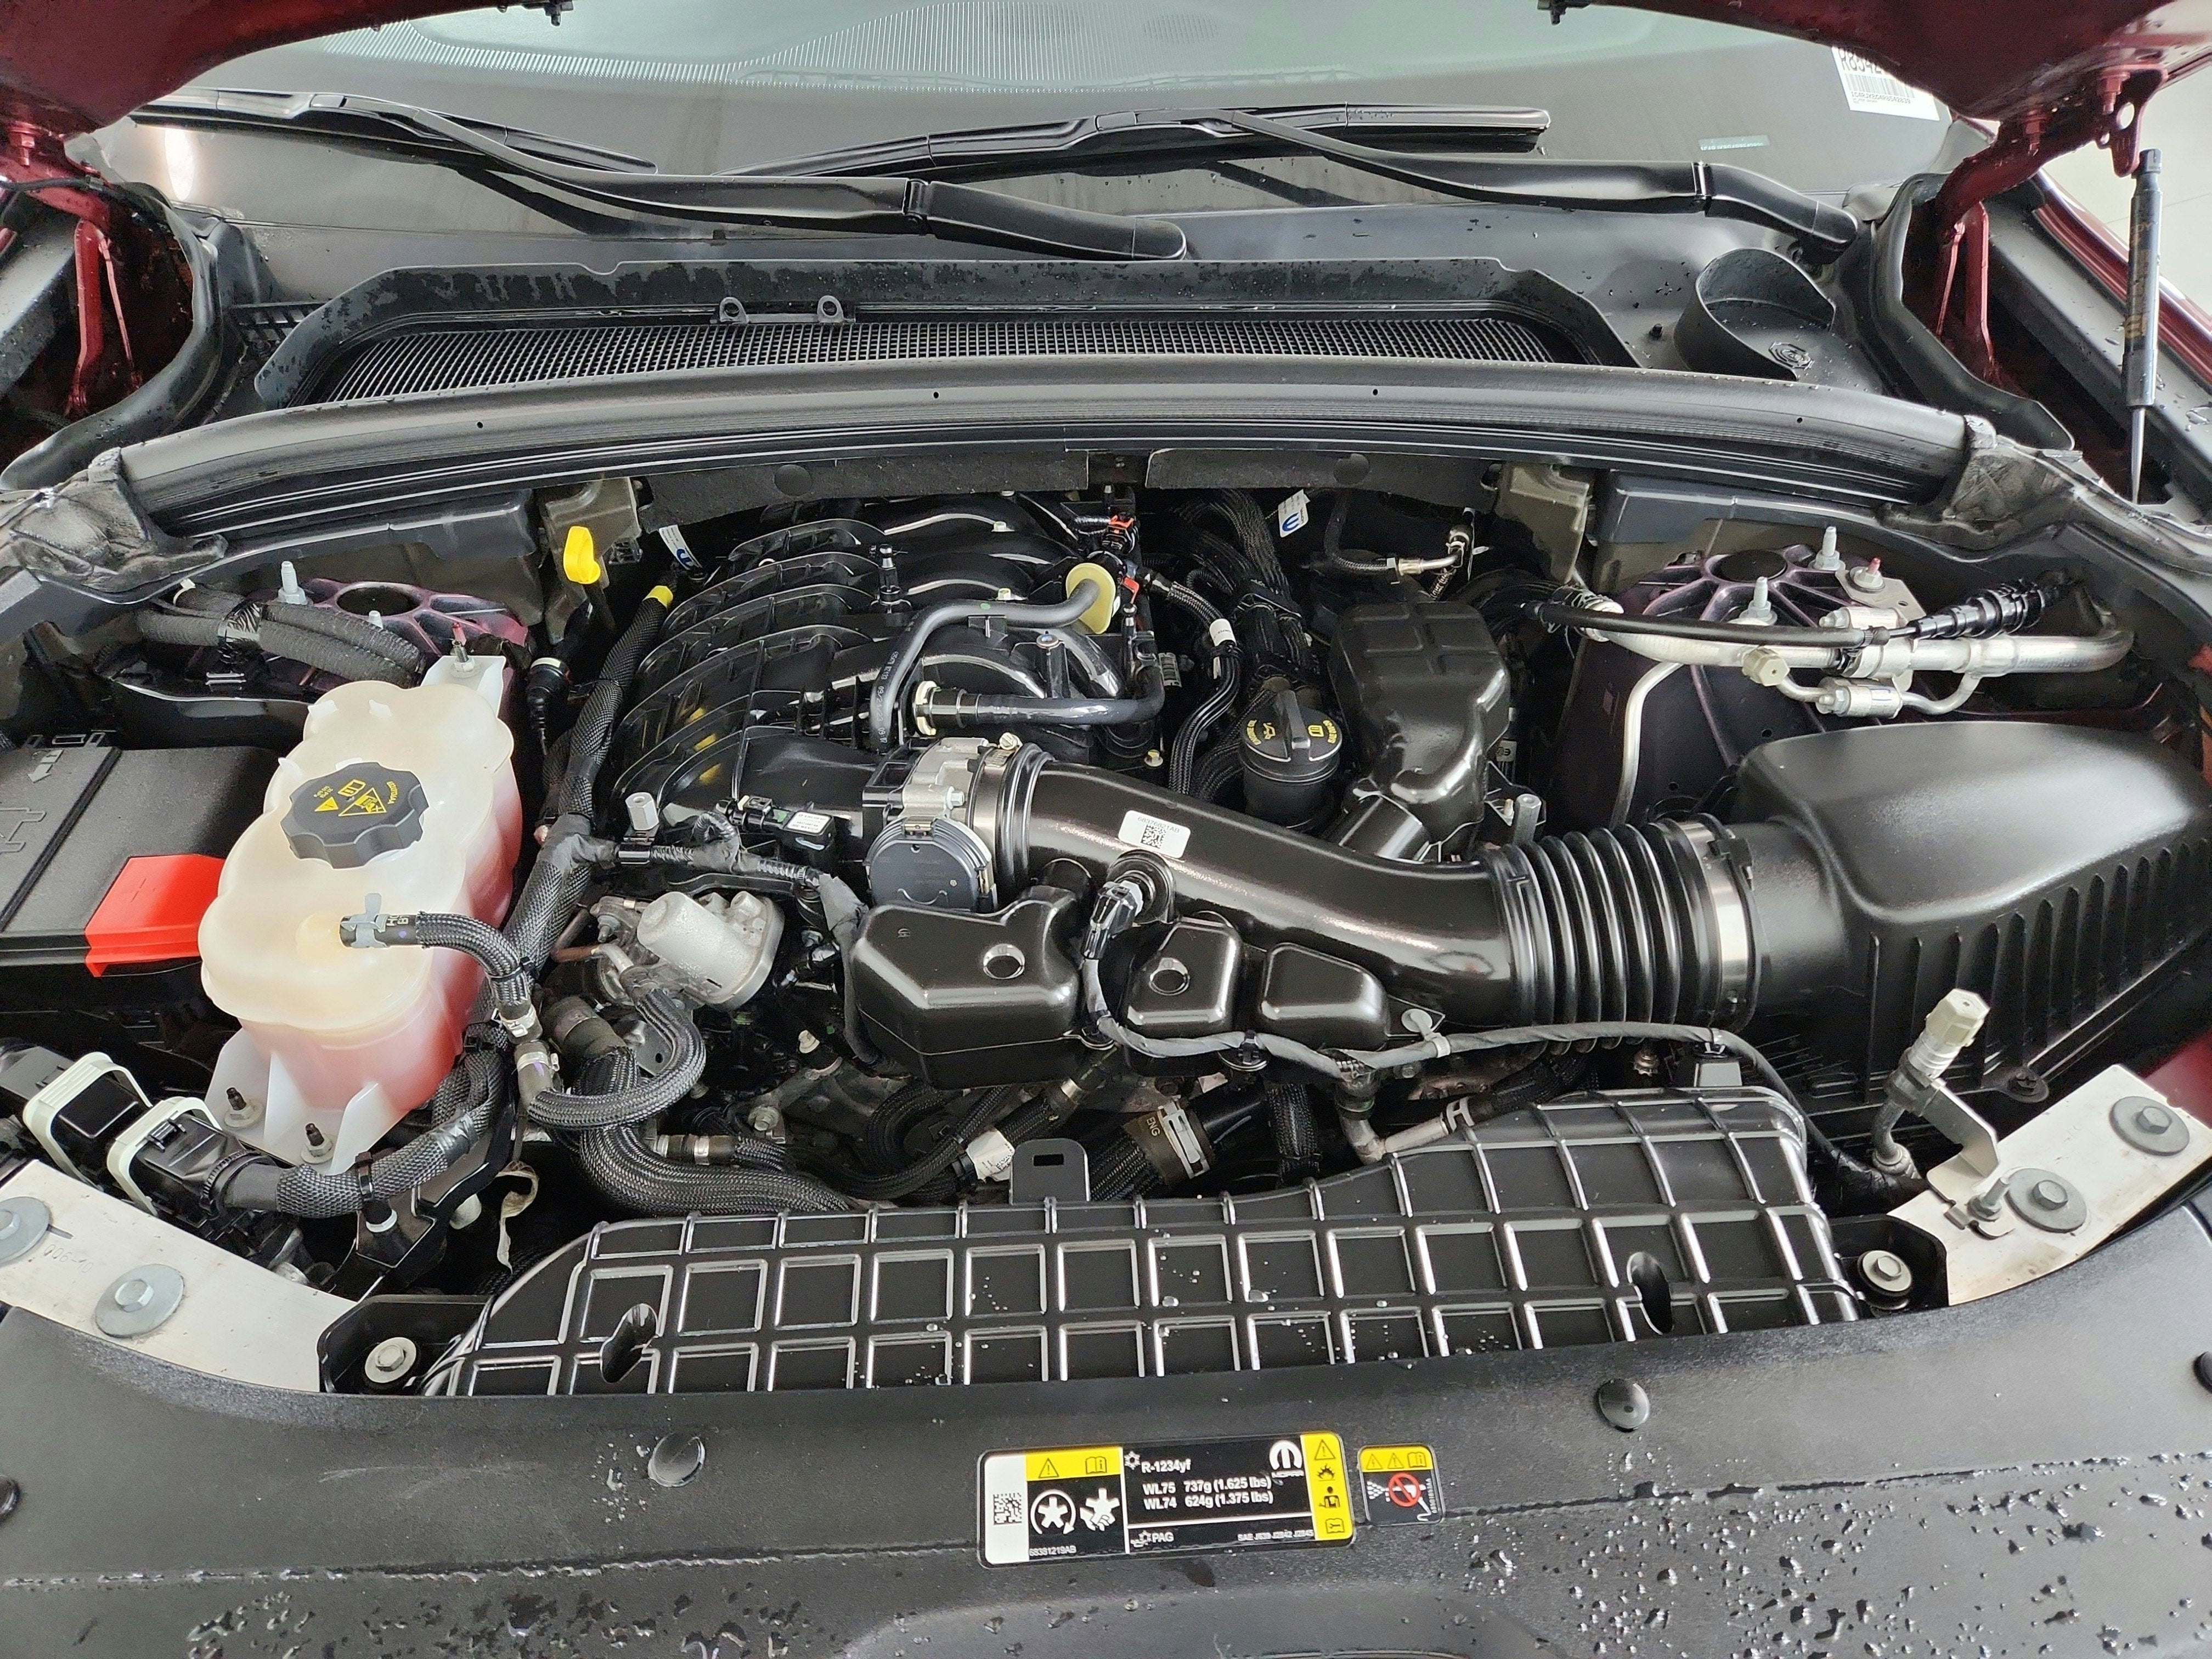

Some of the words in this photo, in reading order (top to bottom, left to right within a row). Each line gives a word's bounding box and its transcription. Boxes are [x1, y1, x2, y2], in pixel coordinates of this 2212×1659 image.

[1137, 816, 1180, 833] 68376821AB
[1146, 1116, 1161, 1137] ENG
[1141, 1458, 1192, 1474] R-1234yf
[1142, 1481, 1176, 1496] WL75
[1183, 1480, 1212, 1493] 737g
[1213, 1476, 1249, 1493] (1.625
[1249, 1475, 1272, 1489] lbs)
[1143, 1496, 1178, 1510] WL74
[1184, 1494, 1214, 1508] 624g
[1215, 1491, 1250, 1508] (1.375
[1250, 1489, 1274, 1504] lbs)
[1152, 1531, 1175, 1543] PAG
[1237, 1533, 1254, 1542] SAE
